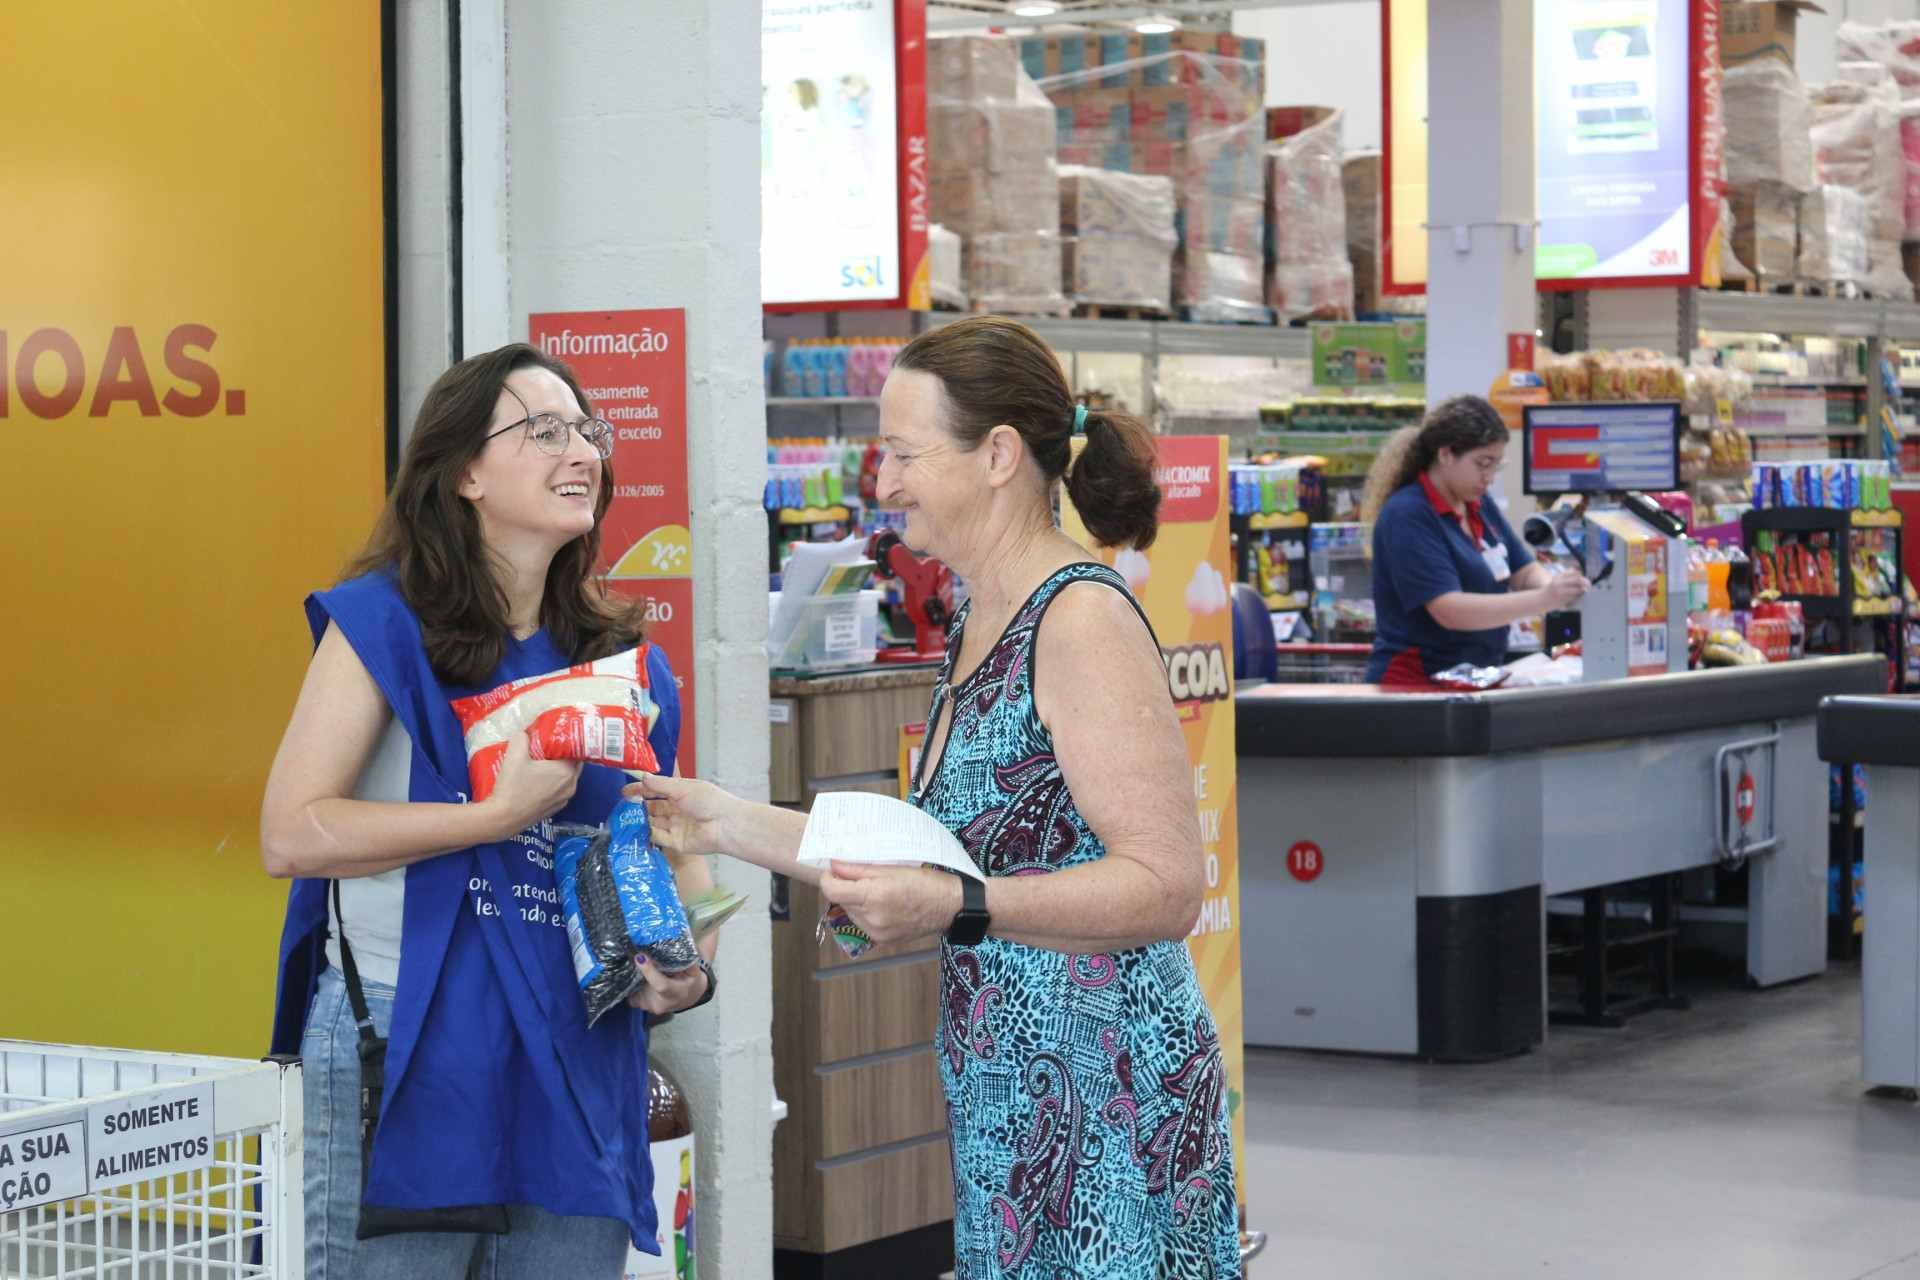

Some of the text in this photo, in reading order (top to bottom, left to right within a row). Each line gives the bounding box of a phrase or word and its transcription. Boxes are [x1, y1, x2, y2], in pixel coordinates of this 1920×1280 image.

[908, 135, 926, 232] BAZAR
[840, 255, 884, 288] sol
[1650, 250, 1679, 267] 3M
[539, 328, 669, 359] Informação
[0, 323, 246, 420] OAS.
[608, 403, 659, 421] entrada
[618, 426, 662, 440] exceto
[1294, 849, 1317, 871] 18
[103, 1097, 199, 1135] SOMENTE
[21, 1132, 70, 1163] SUA
[95, 1136, 208, 1180] ALIMENTOS
